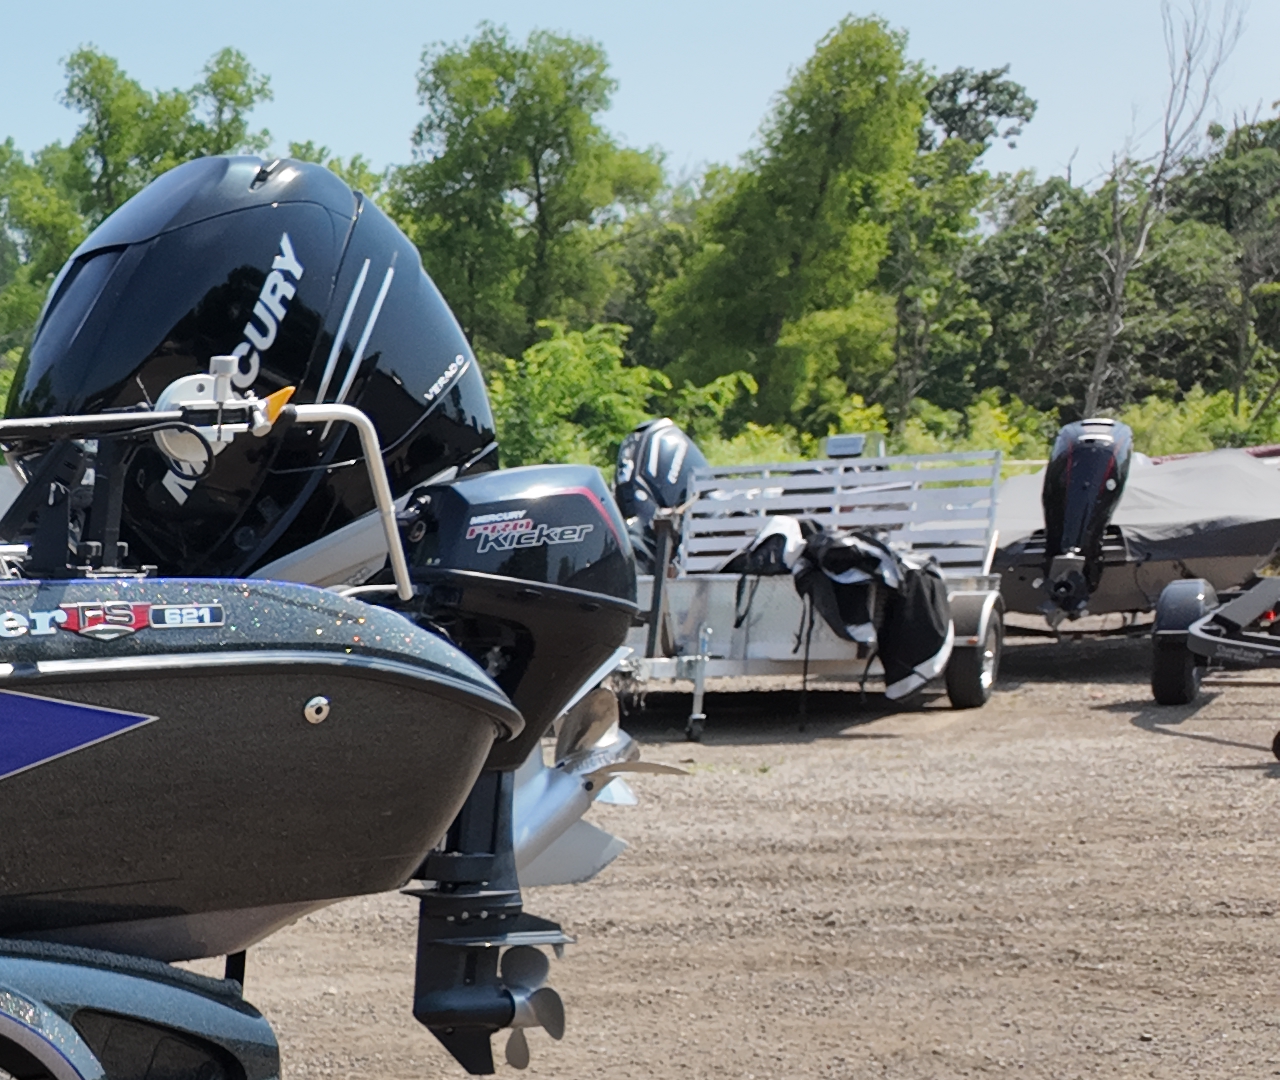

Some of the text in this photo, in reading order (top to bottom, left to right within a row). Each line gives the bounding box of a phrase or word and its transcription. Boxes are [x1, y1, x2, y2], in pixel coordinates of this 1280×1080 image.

[162, 232, 304, 506] MCURY
[424, 354, 464, 400] VERADO
[465, 518, 534, 540] PRO
[469, 509, 527, 526] MERCURY
[77, 600, 136, 630] FS
[164, 607, 211, 625] 621
